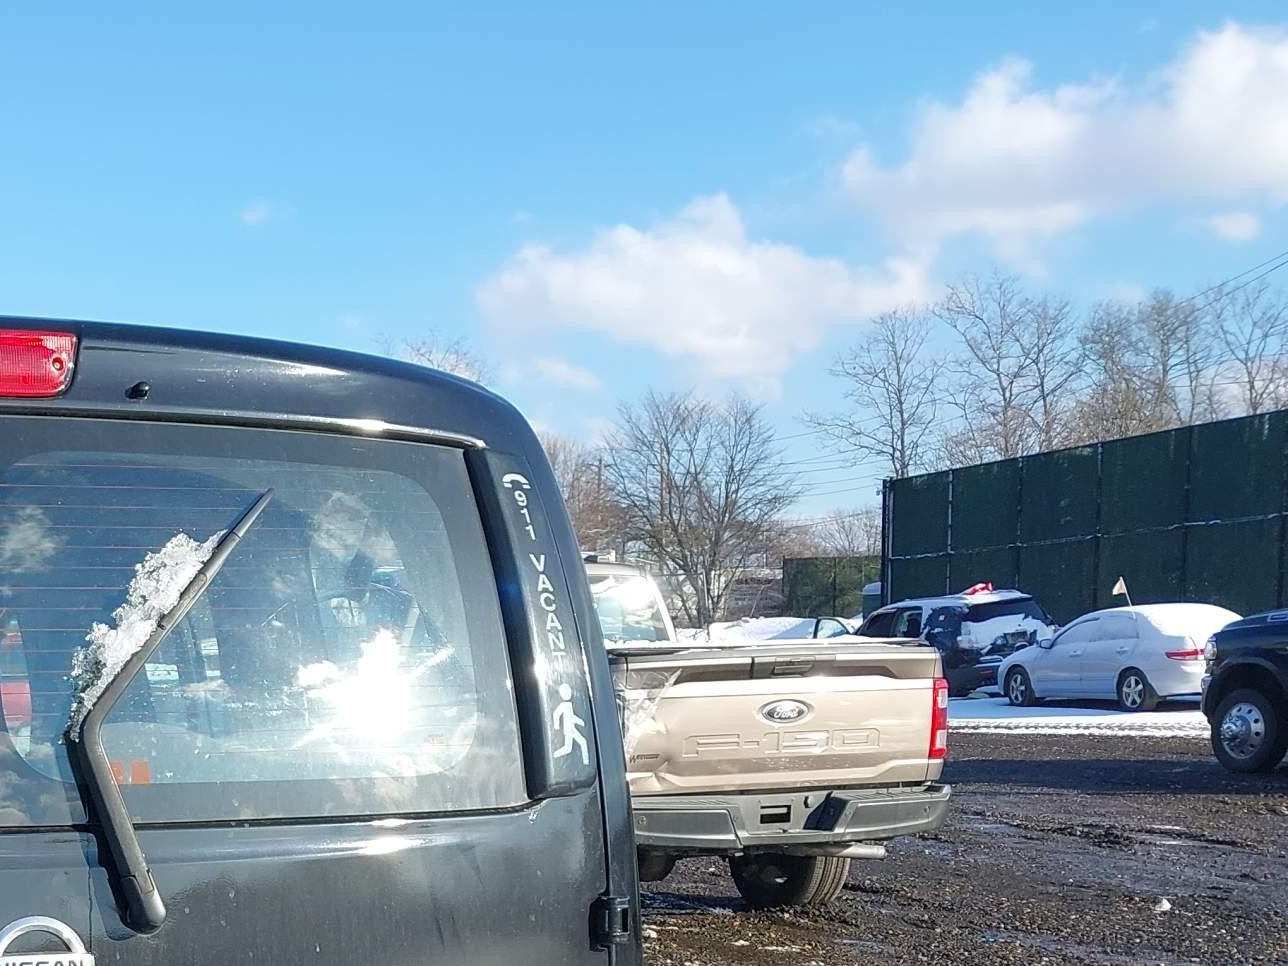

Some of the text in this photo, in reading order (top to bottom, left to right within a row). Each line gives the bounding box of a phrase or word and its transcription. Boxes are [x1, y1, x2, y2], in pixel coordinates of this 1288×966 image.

[514, 490, 567, 672] 911 VACANT
[682, 727, 880, 758] F-150
